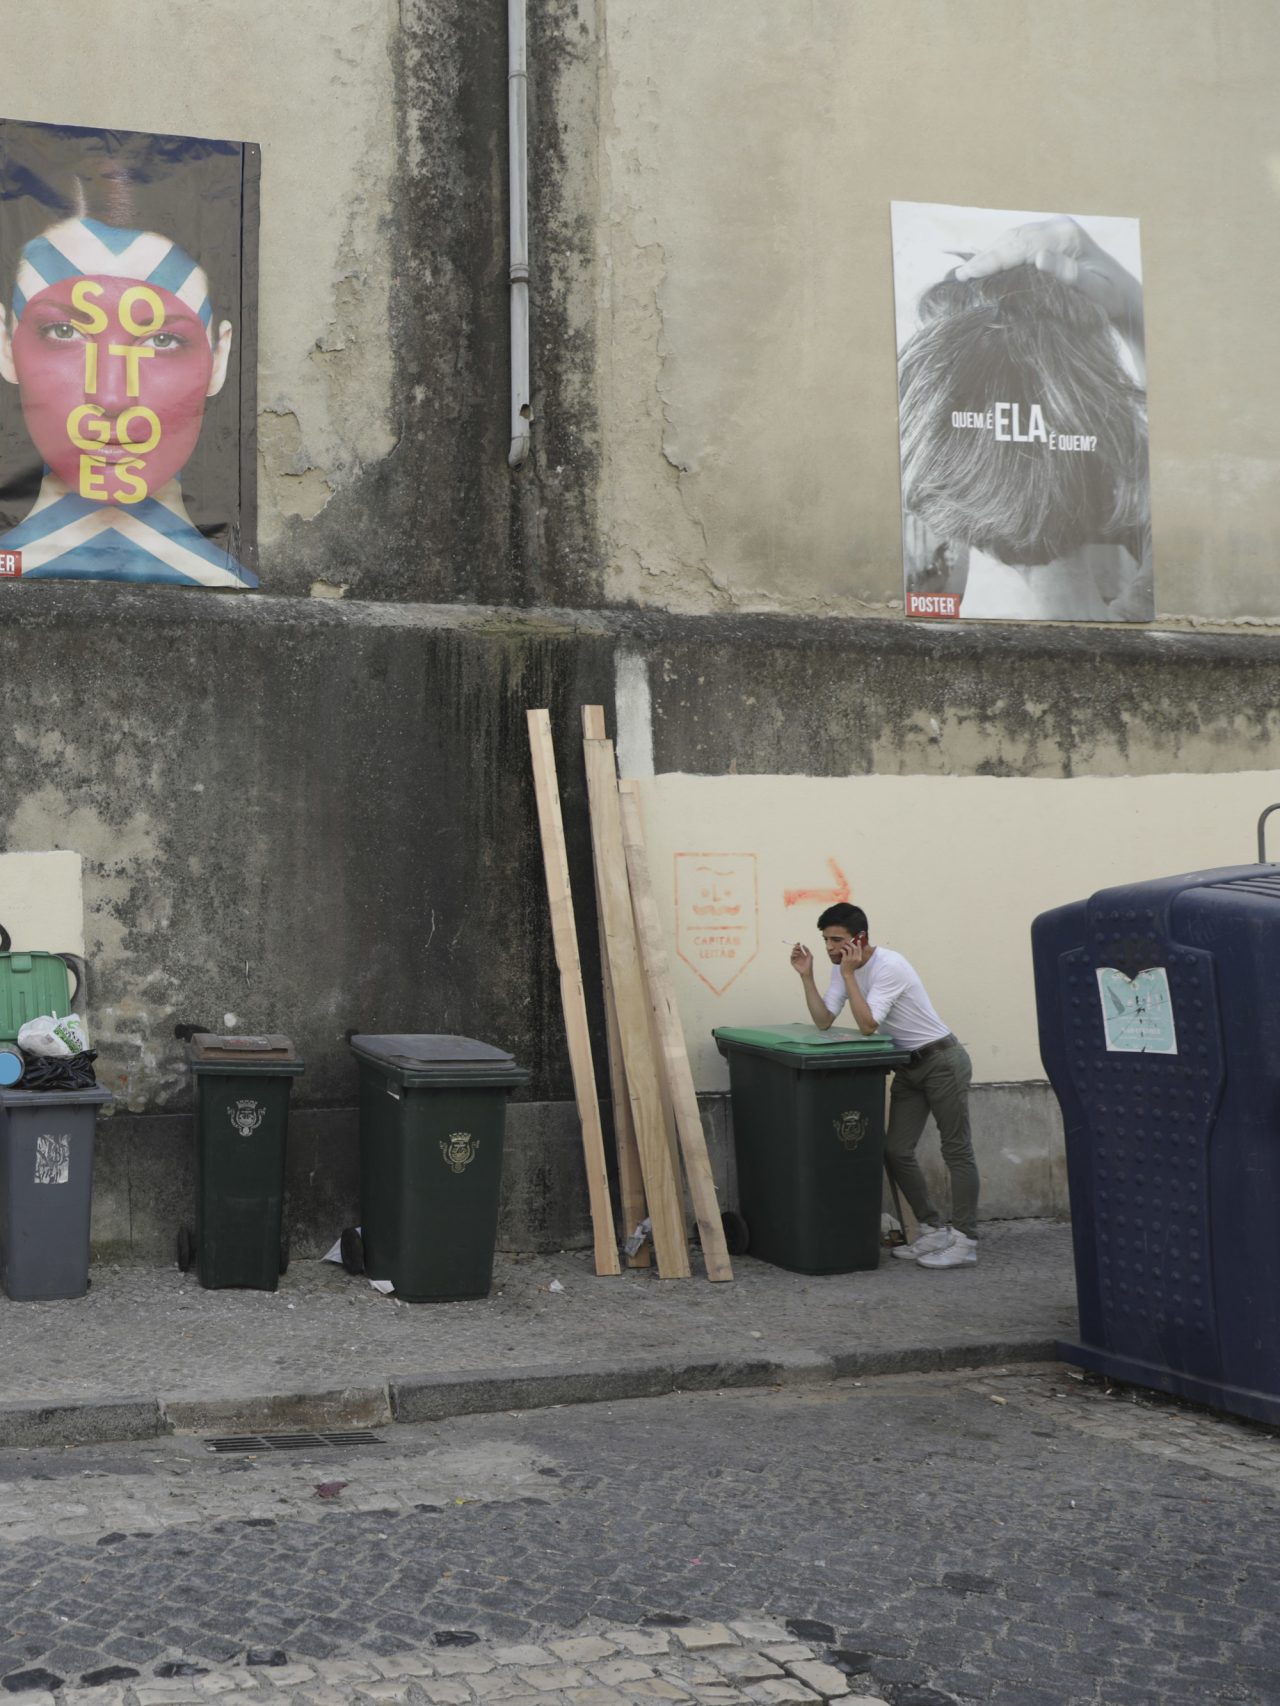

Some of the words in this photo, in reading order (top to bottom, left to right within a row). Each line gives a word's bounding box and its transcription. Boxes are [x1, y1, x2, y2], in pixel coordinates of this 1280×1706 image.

[70, 280, 165, 336] SO
[84, 342, 156, 397] IT
[66, 403, 162, 455] GO
[951, 411, 984, 429] QUEM
[986, 410, 994, 429] É
[995, 402, 1048, 443] ELA
[1048, 431, 1057, 450] É
[1058, 434, 1098, 452] QUEM?
[79, 456, 148, 504] ES
[911, 596, 955, 613] POSTER
